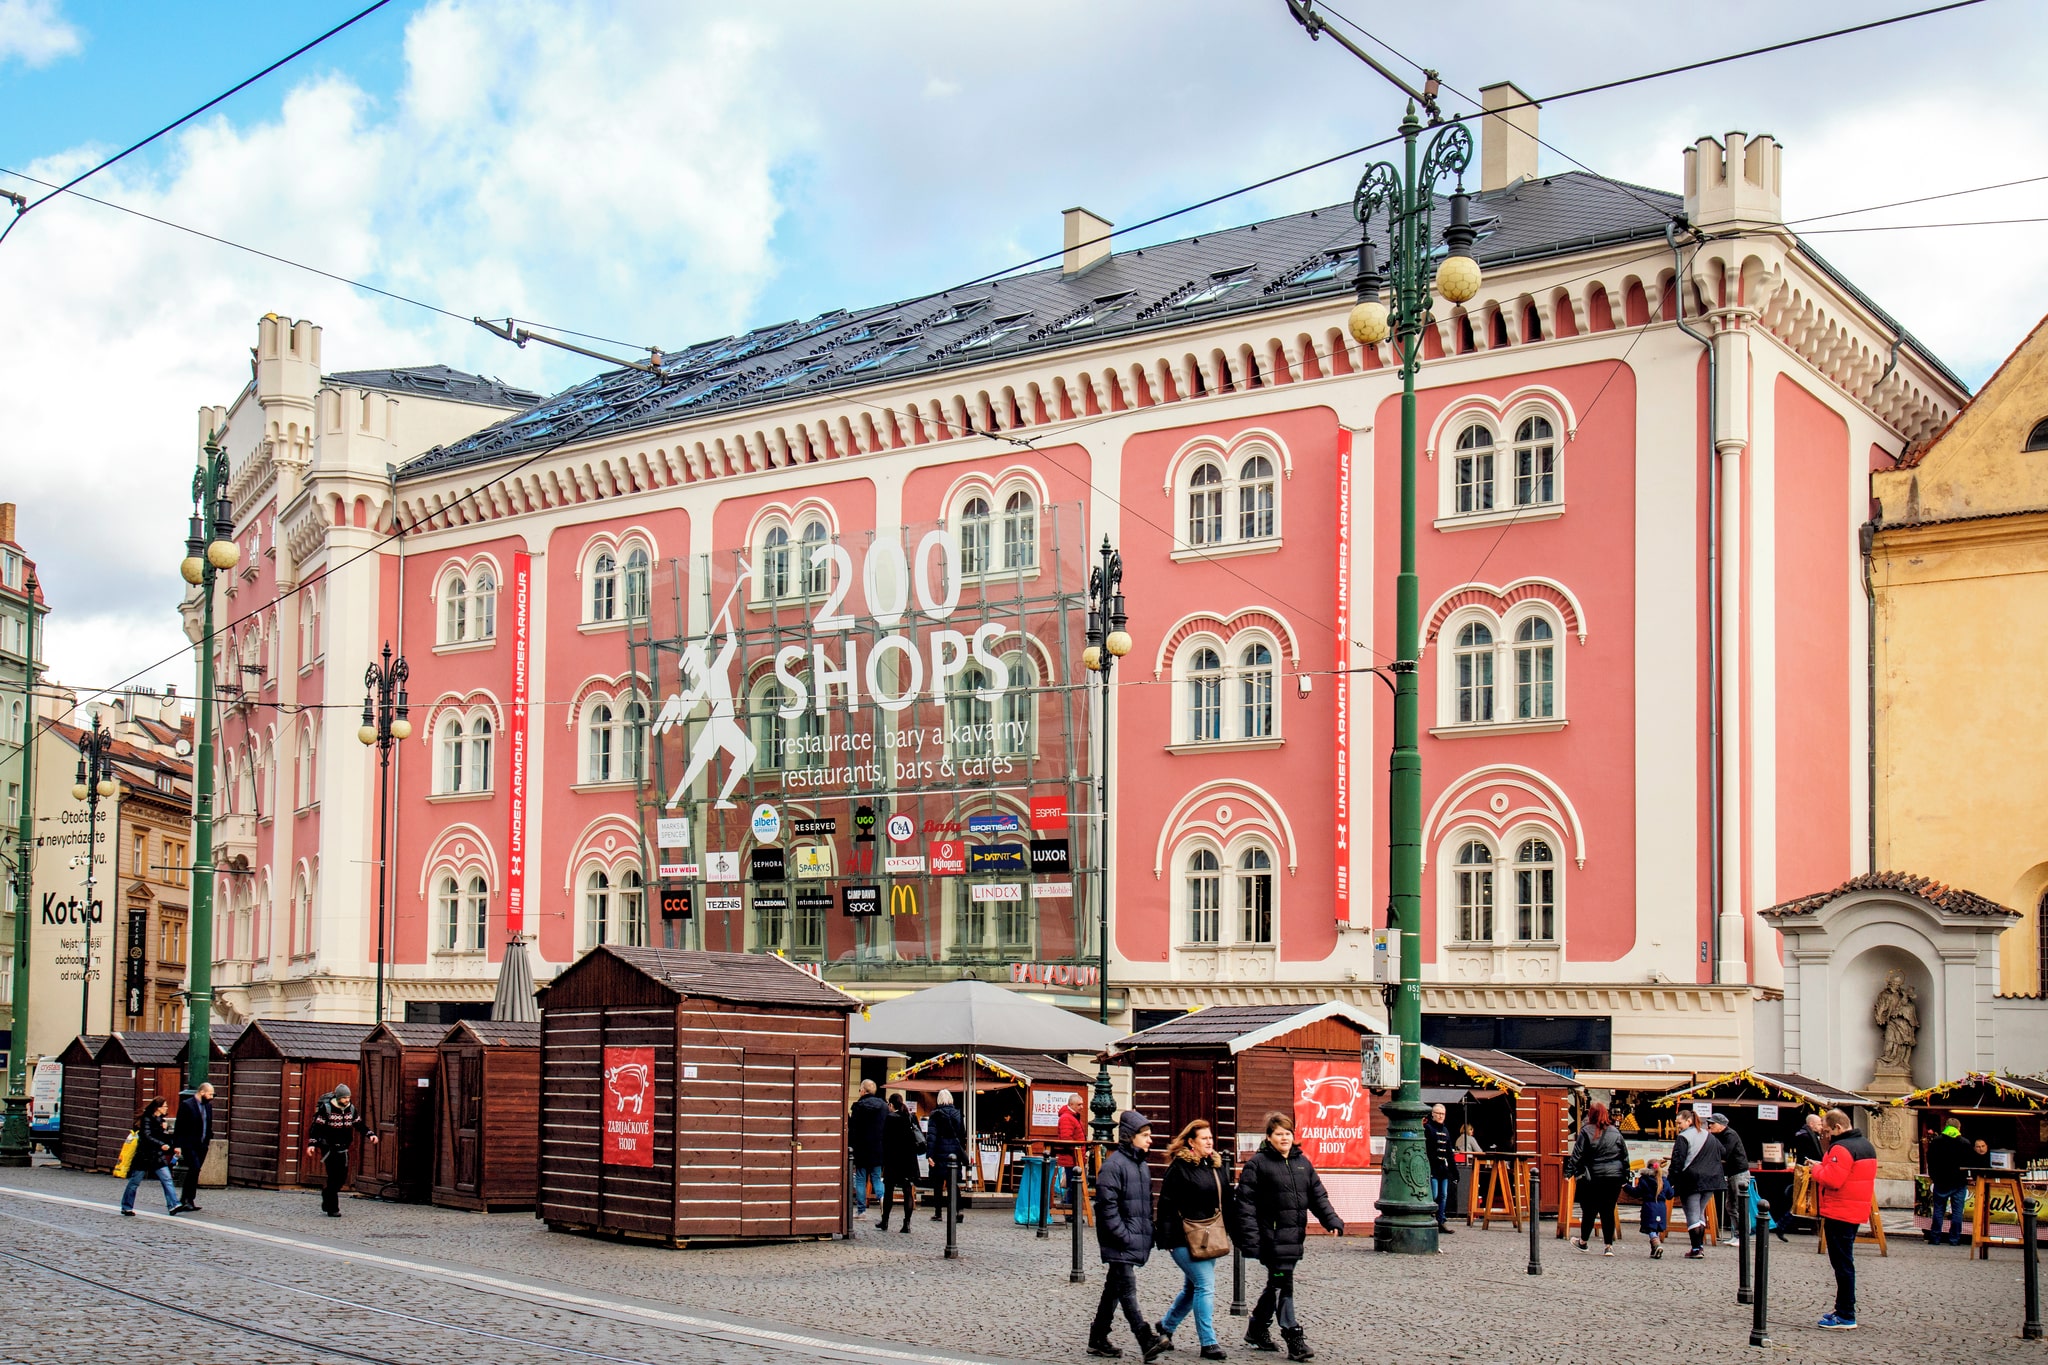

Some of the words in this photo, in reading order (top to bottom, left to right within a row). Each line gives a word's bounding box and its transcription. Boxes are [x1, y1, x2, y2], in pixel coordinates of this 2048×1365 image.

[1340, 453, 1348, 539] ARMOUR
[809, 530, 961, 632] 200
[1338, 543, 1347, 610] UNDER
[517, 569, 527, 639] ARMOUR
[516, 641, 525, 693] UNDER
[774, 622, 1010, 720] SHOPS
[780, 732, 877, 755] restaurace,
[884, 724, 925, 753] bary
[932, 727, 944, 745] a
[950, 719, 1028, 746] kavárny
[514, 731, 523, 796] ARMOUR
[782, 760, 887, 788] restaurants,
[894, 756, 933, 780] bars
[940, 754, 956, 778] &
[962, 750, 1013, 776] cafés
[1338, 750, 1346, 818] UNDER
[96, 811, 106, 822] se
[856, 816, 874, 824] UGO
[1036, 808, 1061, 818] ESPRIT
[512, 800, 522, 852] UNDER
[754, 816, 777, 826] albert
[795, 822, 836, 831] RESERVED
[891, 820, 910, 835] C&A
[47, 830, 105, 848] nevycházete
[1033, 850, 1066, 861] LUXOR
[799, 863, 830, 872] SPARKYS
[888, 858, 920, 870] orsay
[975, 887, 1018, 898] LINDEX
[42, 892, 102, 924] Kotva
[664, 899, 688, 911] CCC
[60, 970, 69, 980] od
[1010, 963, 1098, 986] PALLADIUM
[608, 1120, 649, 1135] ZABIJAČKOVÉ
[1302, 1126, 1363, 1139] ZABIJAČKOVÉ
[618, 1138, 636, 1150] HODY
[1319, 1142, 1346, 1154] HODY
